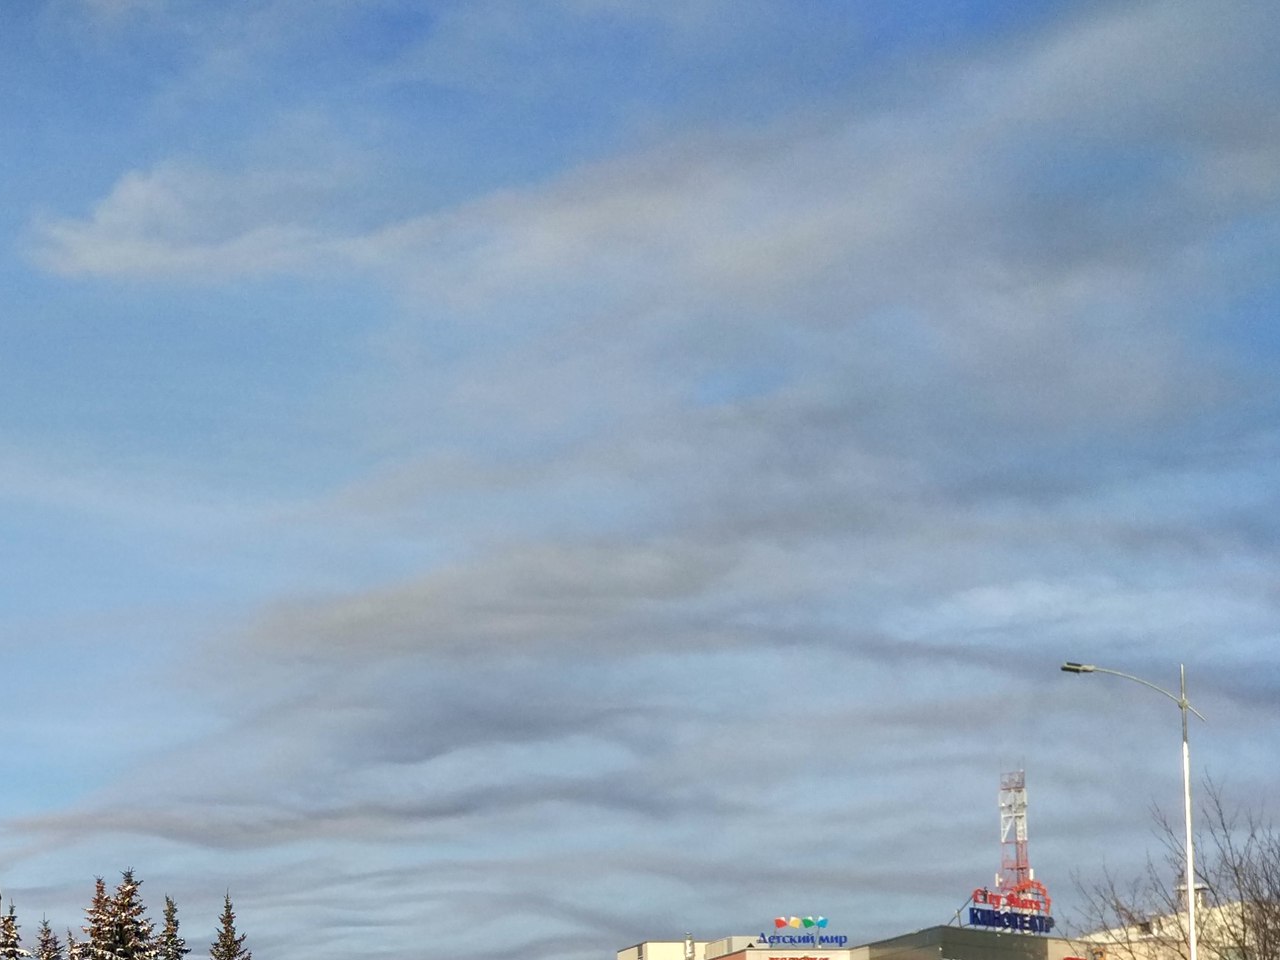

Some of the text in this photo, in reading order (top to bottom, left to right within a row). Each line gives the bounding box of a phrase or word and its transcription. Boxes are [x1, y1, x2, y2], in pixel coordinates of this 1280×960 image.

[969, 907, 1054, 933] КИНОТЕАТР
[757, 932, 848, 947] Детский мир
